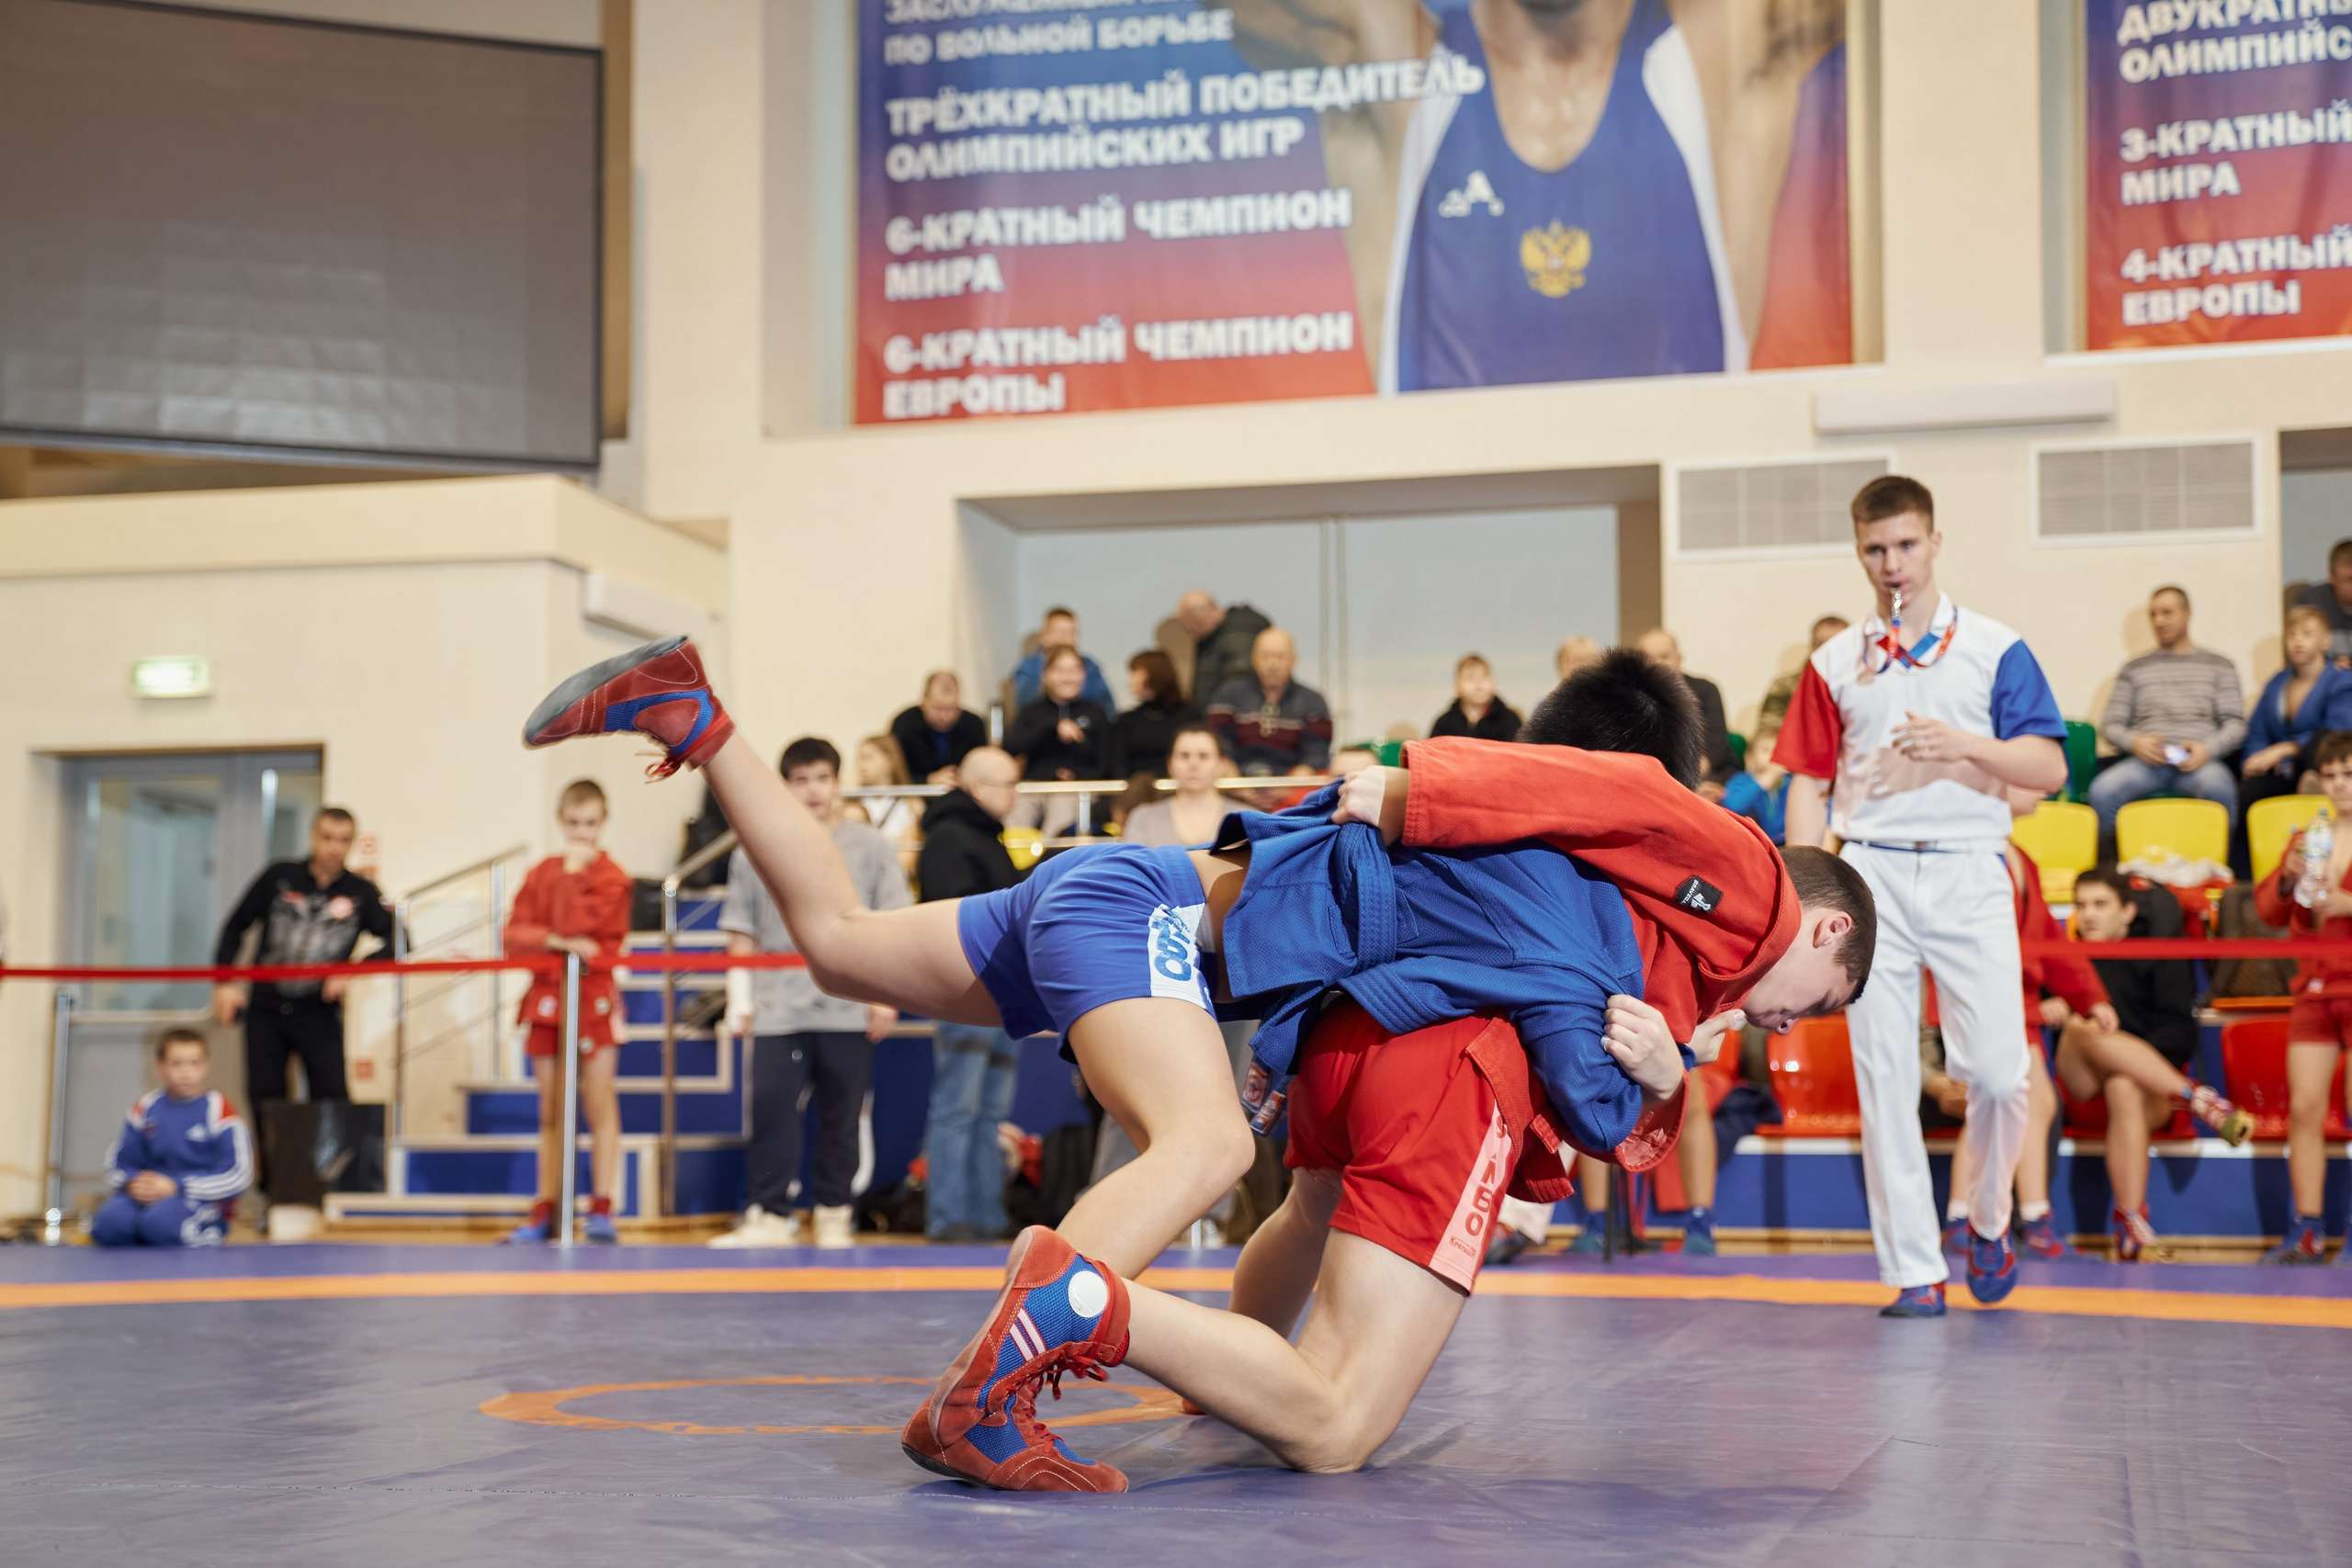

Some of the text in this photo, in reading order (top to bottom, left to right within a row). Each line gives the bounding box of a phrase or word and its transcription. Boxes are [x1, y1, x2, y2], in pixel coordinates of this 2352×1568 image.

[884, 8, 1234, 65] ПО ВОЛЬНОЙ БОРЬБЕ
[885, 53, 1486, 135] ТРЁХКРАТНЫЙ ПОБЕДИТЕЛЬ
[885, 116, 1306, 182] ОЛИМПИЙСКИХ ИГР
[2120, 160, 2242, 206] МИРА
[885, 187, 1353, 255] 6-КРАТНЫЙ ЧЕМПИОН
[885, 254, 1004, 301] МИРА
[2120, 278, 2301, 327] ЕВРОПЫ
[883, 310, 1353, 374] 6-КРАТНЫЙ ЧЕМПИОН
[883, 372, 1066, 419] ЕВРОПЫ
